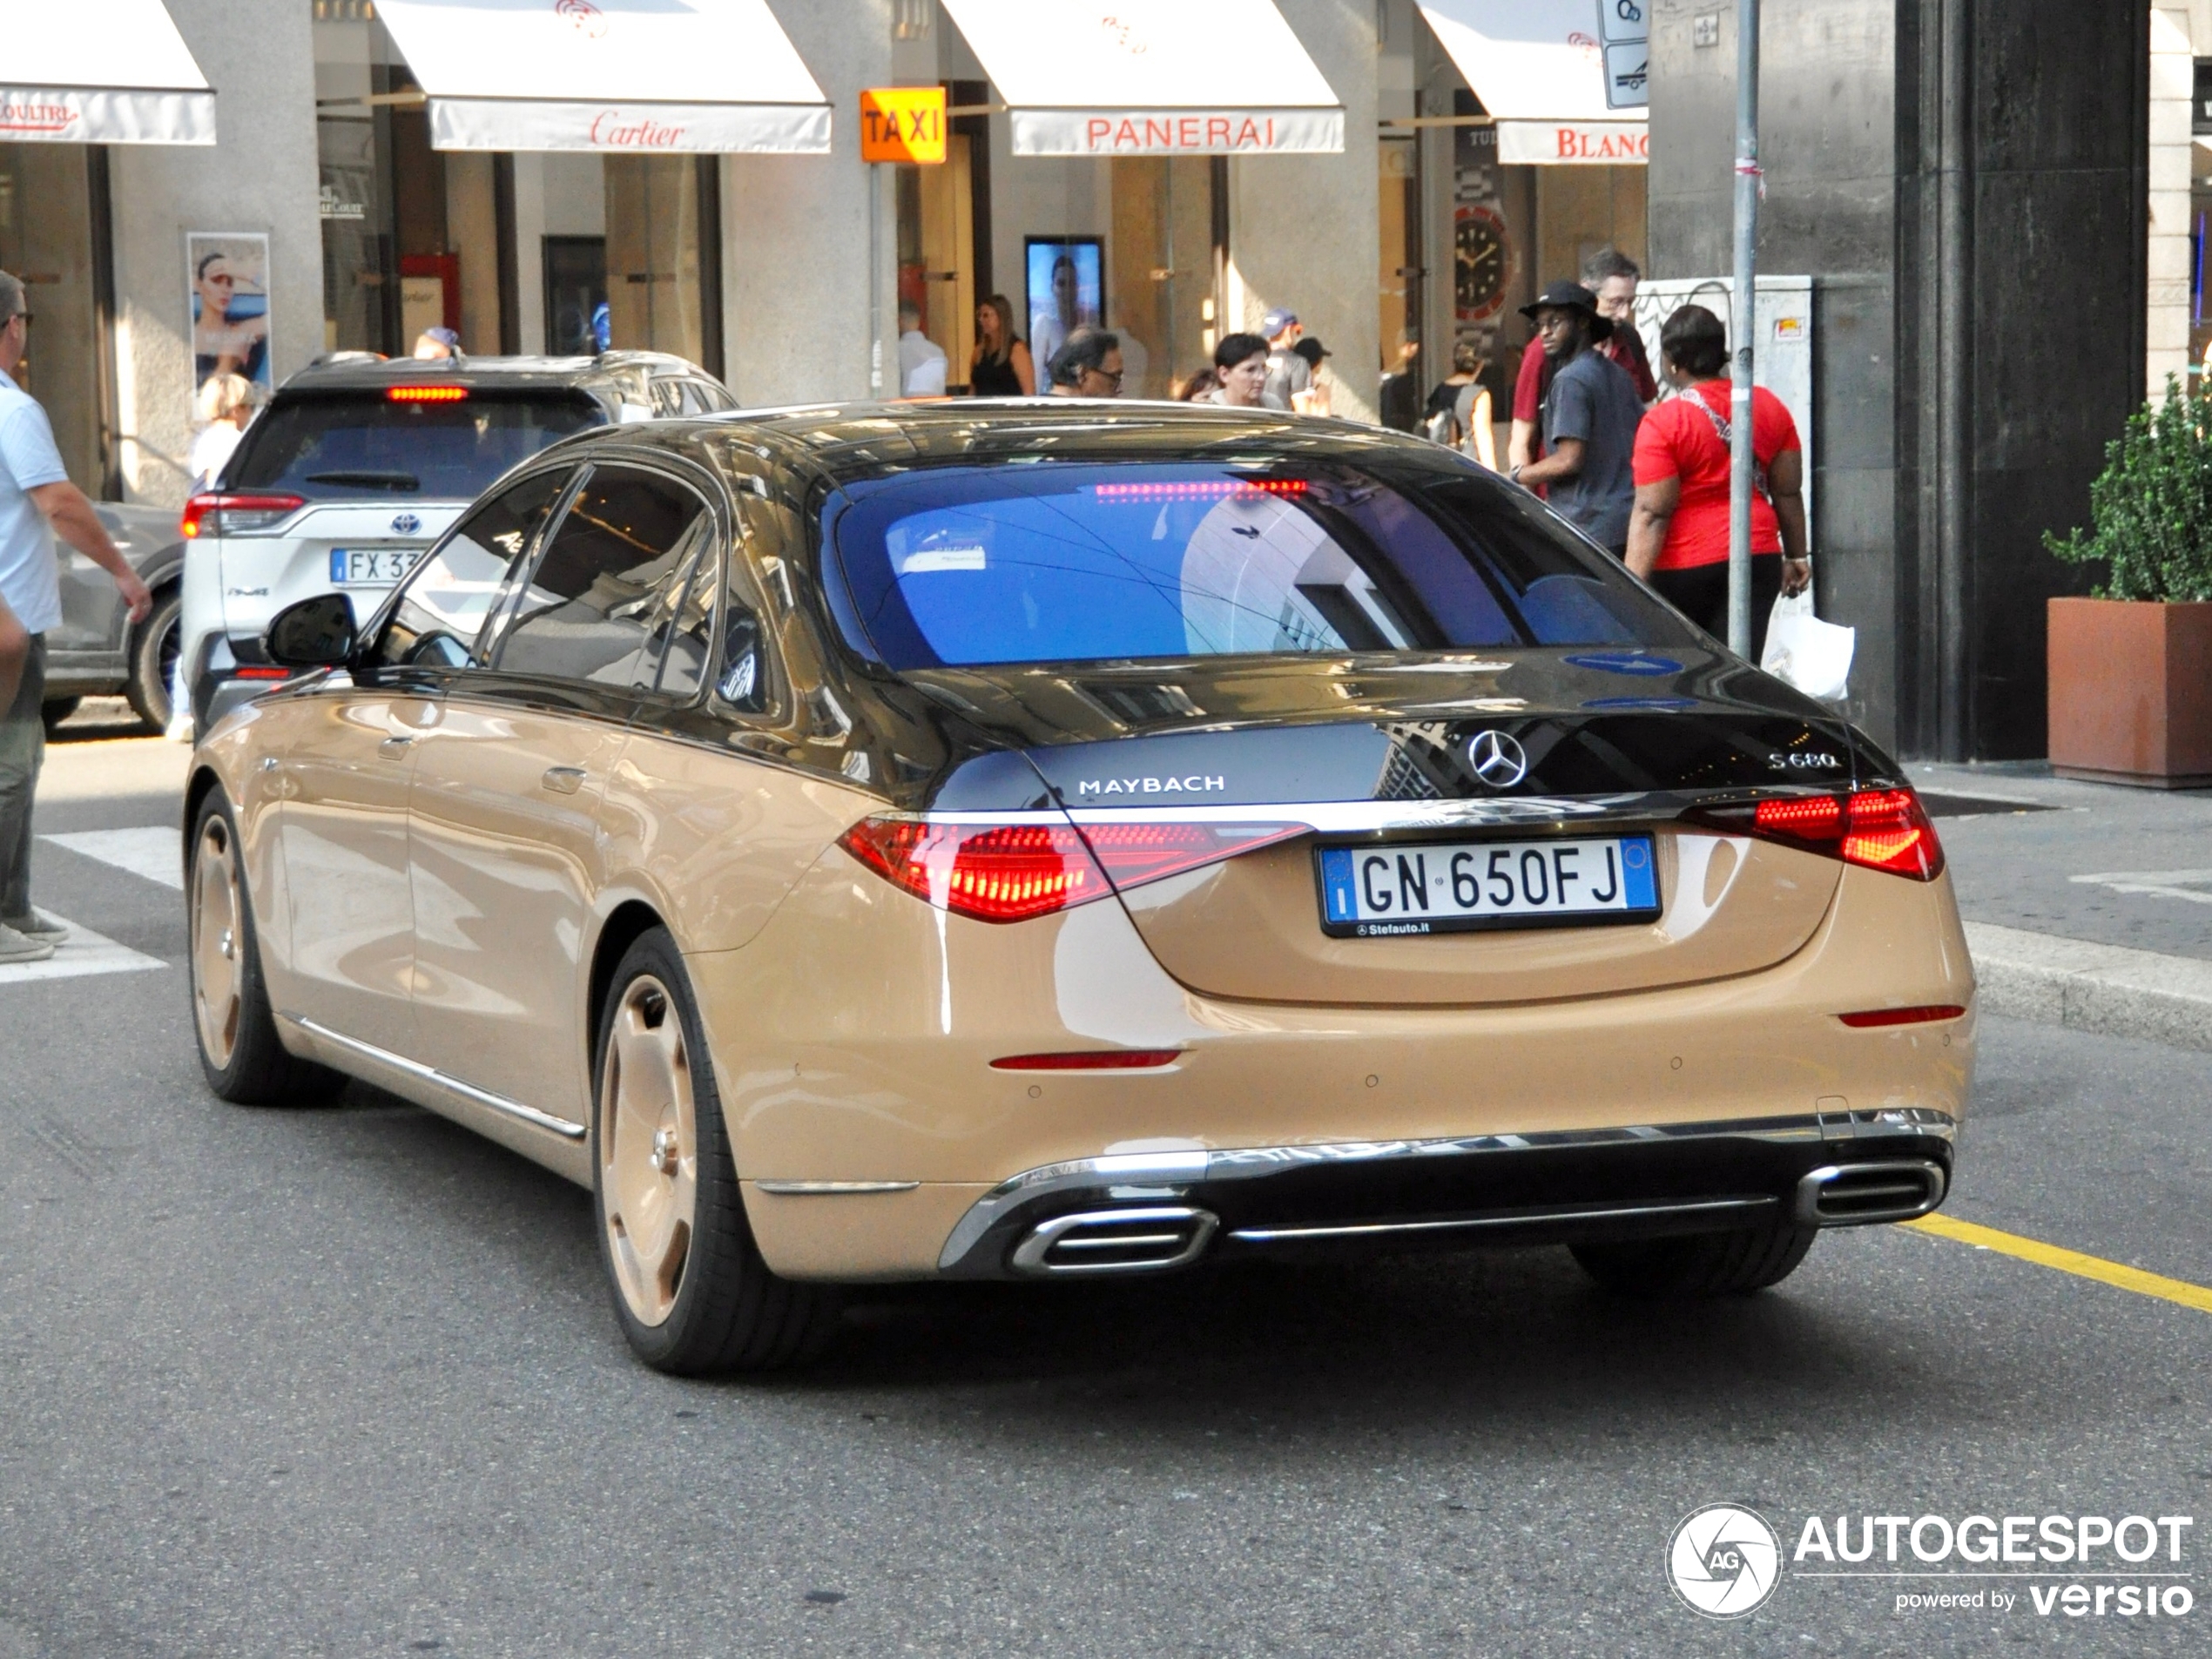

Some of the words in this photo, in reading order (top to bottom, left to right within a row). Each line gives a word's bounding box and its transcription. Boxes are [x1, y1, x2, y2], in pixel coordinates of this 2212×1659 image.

[590, 110, 685, 146] Cartier
[866, 109, 939, 142] TAXI
[1087, 117, 1274, 148] PANERAI
[350, 553, 379, 578] FX
[1079, 775, 1225, 795] MAYBACH
[1362, 853, 1429, 913] GN
[1369, 922, 1430, 935] Stefauto.it
